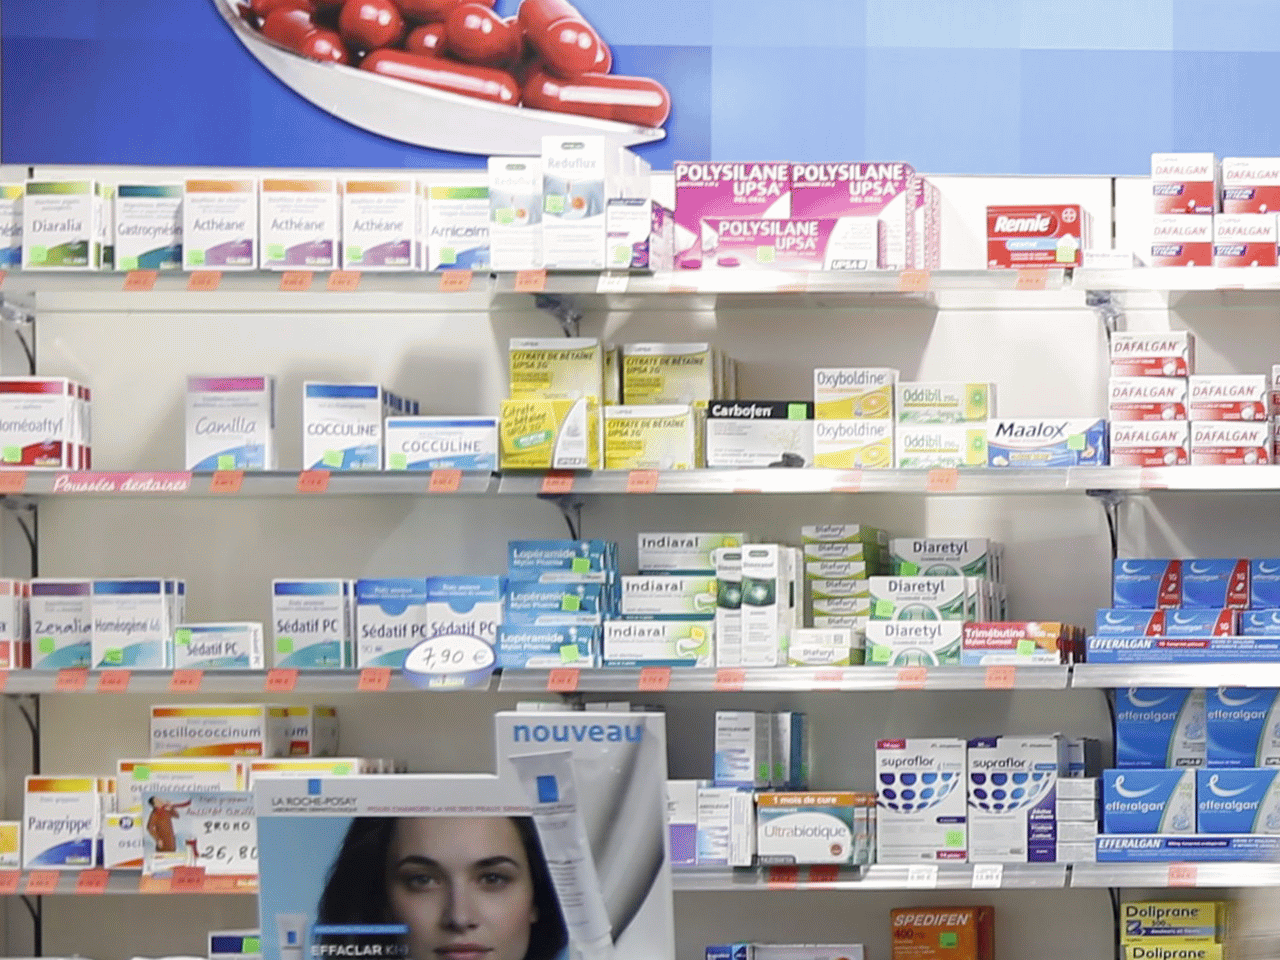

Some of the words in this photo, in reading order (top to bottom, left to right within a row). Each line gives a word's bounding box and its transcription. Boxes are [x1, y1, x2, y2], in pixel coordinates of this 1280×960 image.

[676, 164, 788, 181] POLYSILANE
[792, 164, 904, 181] POLYSILANE
[732, 182, 779, 196] UPSA
[849, 182, 896, 196] UPSA
[32, 219, 82, 232] Diaralia
[194, 218, 245, 232] Acthéane
[994, 215, 1051, 234] Rennie
[1114, 340, 1177, 354] DAFALGAN
[816, 371, 885, 388] Oxyboldine
[904, 388, 941, 403] Oddibil
[712, 404, 772, 419] Carbofen
[308, 422, 378, 436] COCCULINE
[996, 422, 1067, 438] Maalox
[642, 536, 699, 549] Indiaral
[913, 540, 968, 556] Diaretyl
[277, 618, 319, 633] Sédatif
[322, 619, 338, 632] PC
[1090, 639, 1151, 650] EFFERALGAN
[1118, 709, 1176, 724] efferalgan
[153, 724, 261, 738] oscillococcinum
[514, 723, 641, 743] nouveau
[881, 756, 935, 771] supraflor
[28, 816, 92, 834] Paragrippe
[764, 824, 847, 840] Ultrabiotique
[1125, 905, 1199, 920] Doliprane
[894, 914, 970, 928] SPEDIFEN
[311, 945, 382, 956] EFFACLAR
